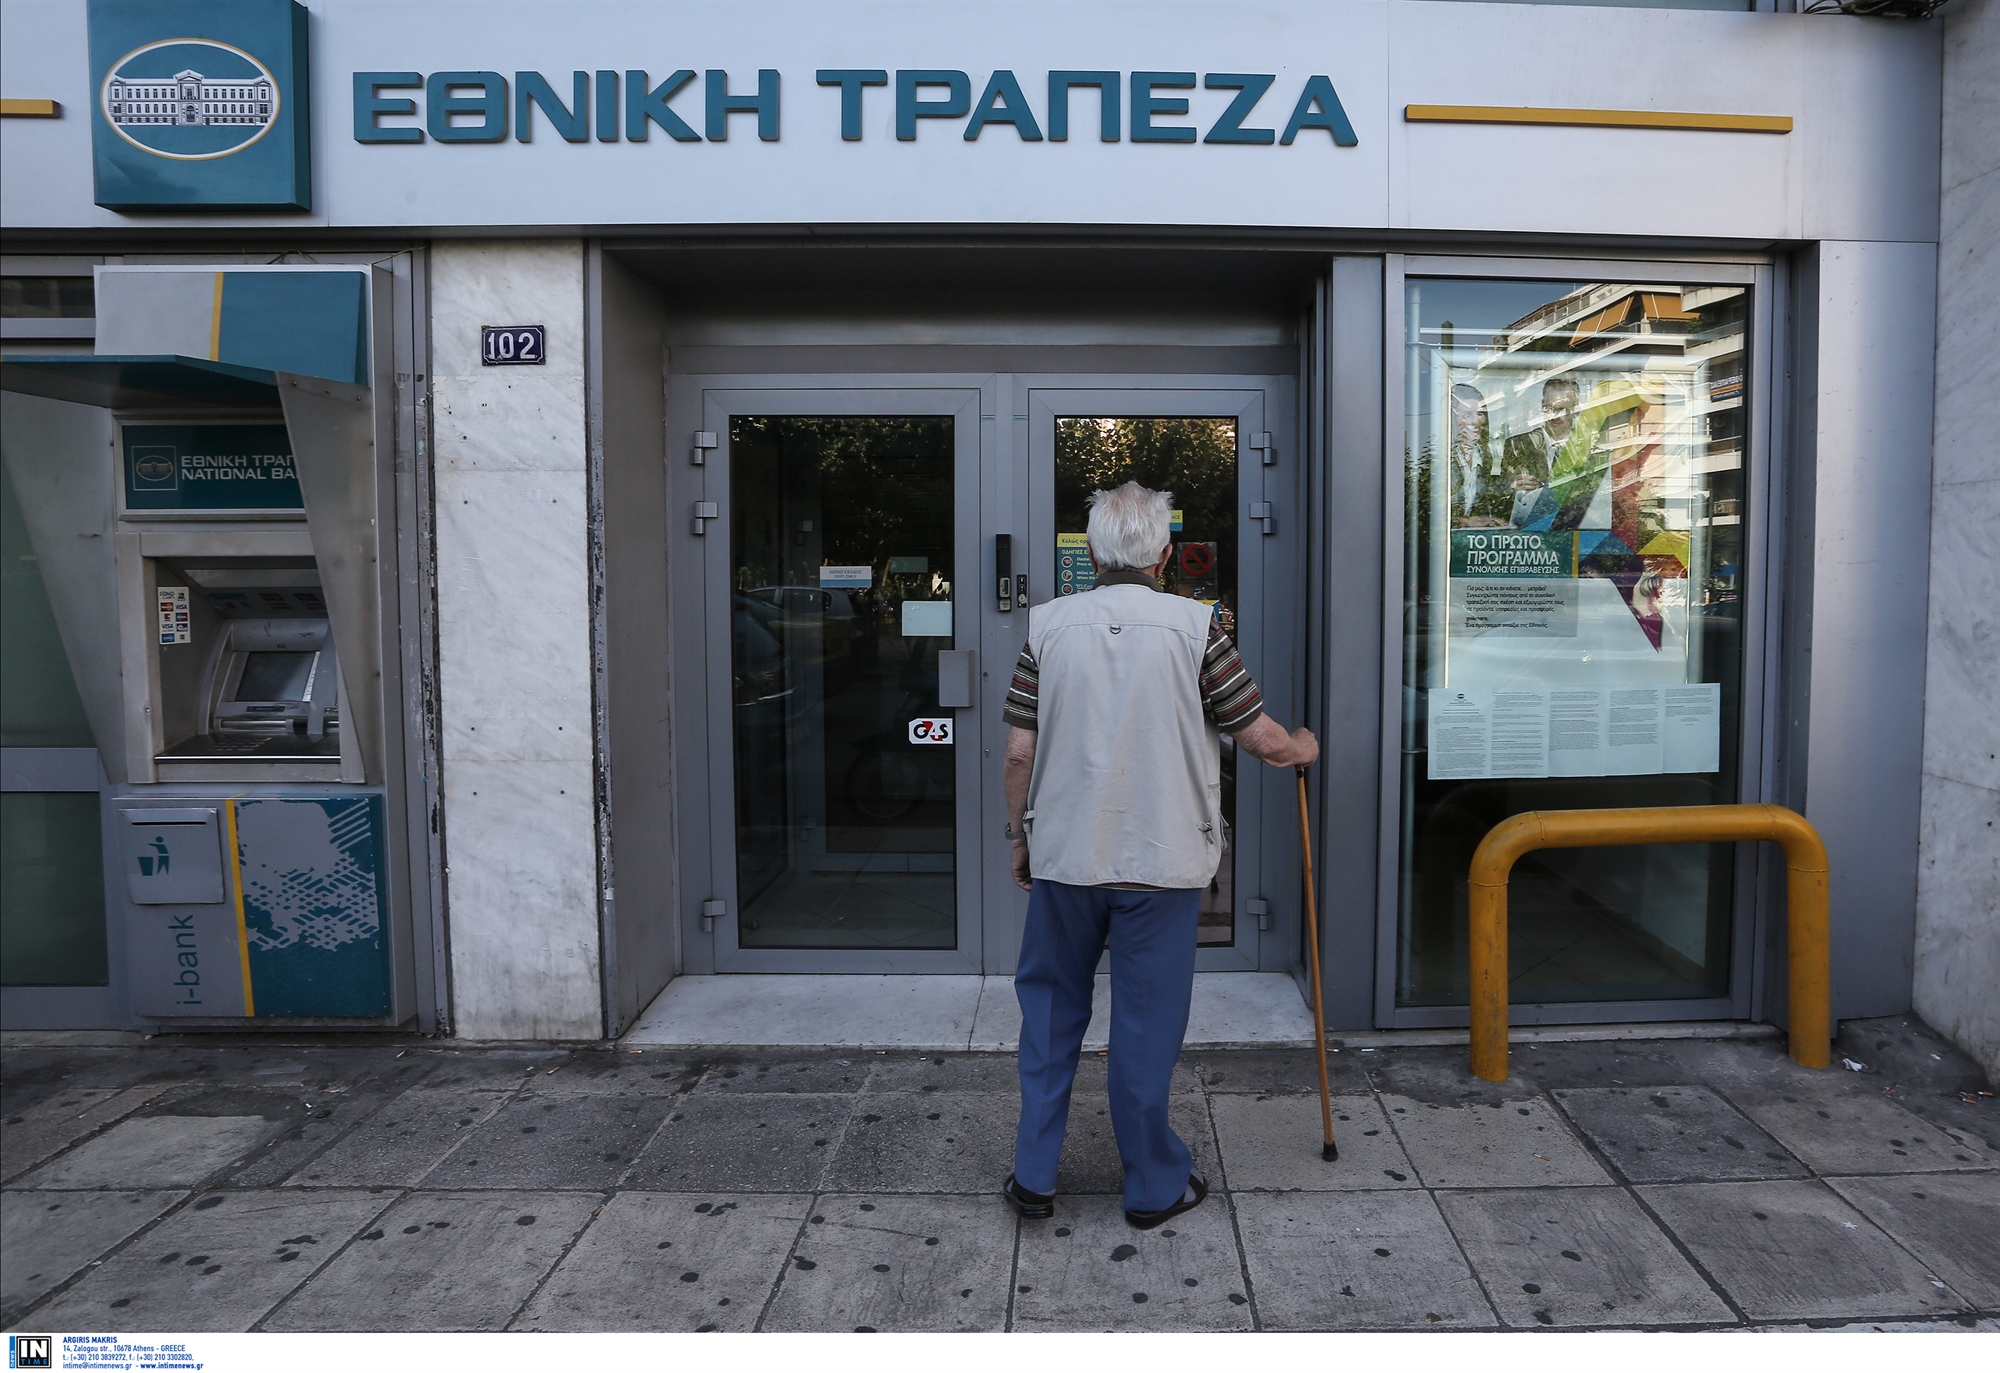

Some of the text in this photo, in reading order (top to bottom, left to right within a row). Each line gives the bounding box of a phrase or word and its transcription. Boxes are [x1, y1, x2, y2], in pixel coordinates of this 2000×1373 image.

[353, 68, 1358, 146] ΕΘΝΙΚΗ ΤΡΑΠΕΖΑ
[488, 332, 535, 359] 102
[181, 455, 247, 467] ΕΘΝΙΚΗ
[181, 468, 298, 480] NATIONAL BA
[1467, 535, 1541, 549] ΤΟ ΠΡΩΤΟ
[1467, 551, 1559, 565] ΠΡΟΓΡΑΜΜΑ
[1466, 566, 1560, 574] ΣΥΝΟΛΙΚΗΣ ΕΠΙΒΡΑΒΕΥΣΗΣ
[913, 721, 949, 741] G4S
[167, 913, 203, 1005] i-bank
